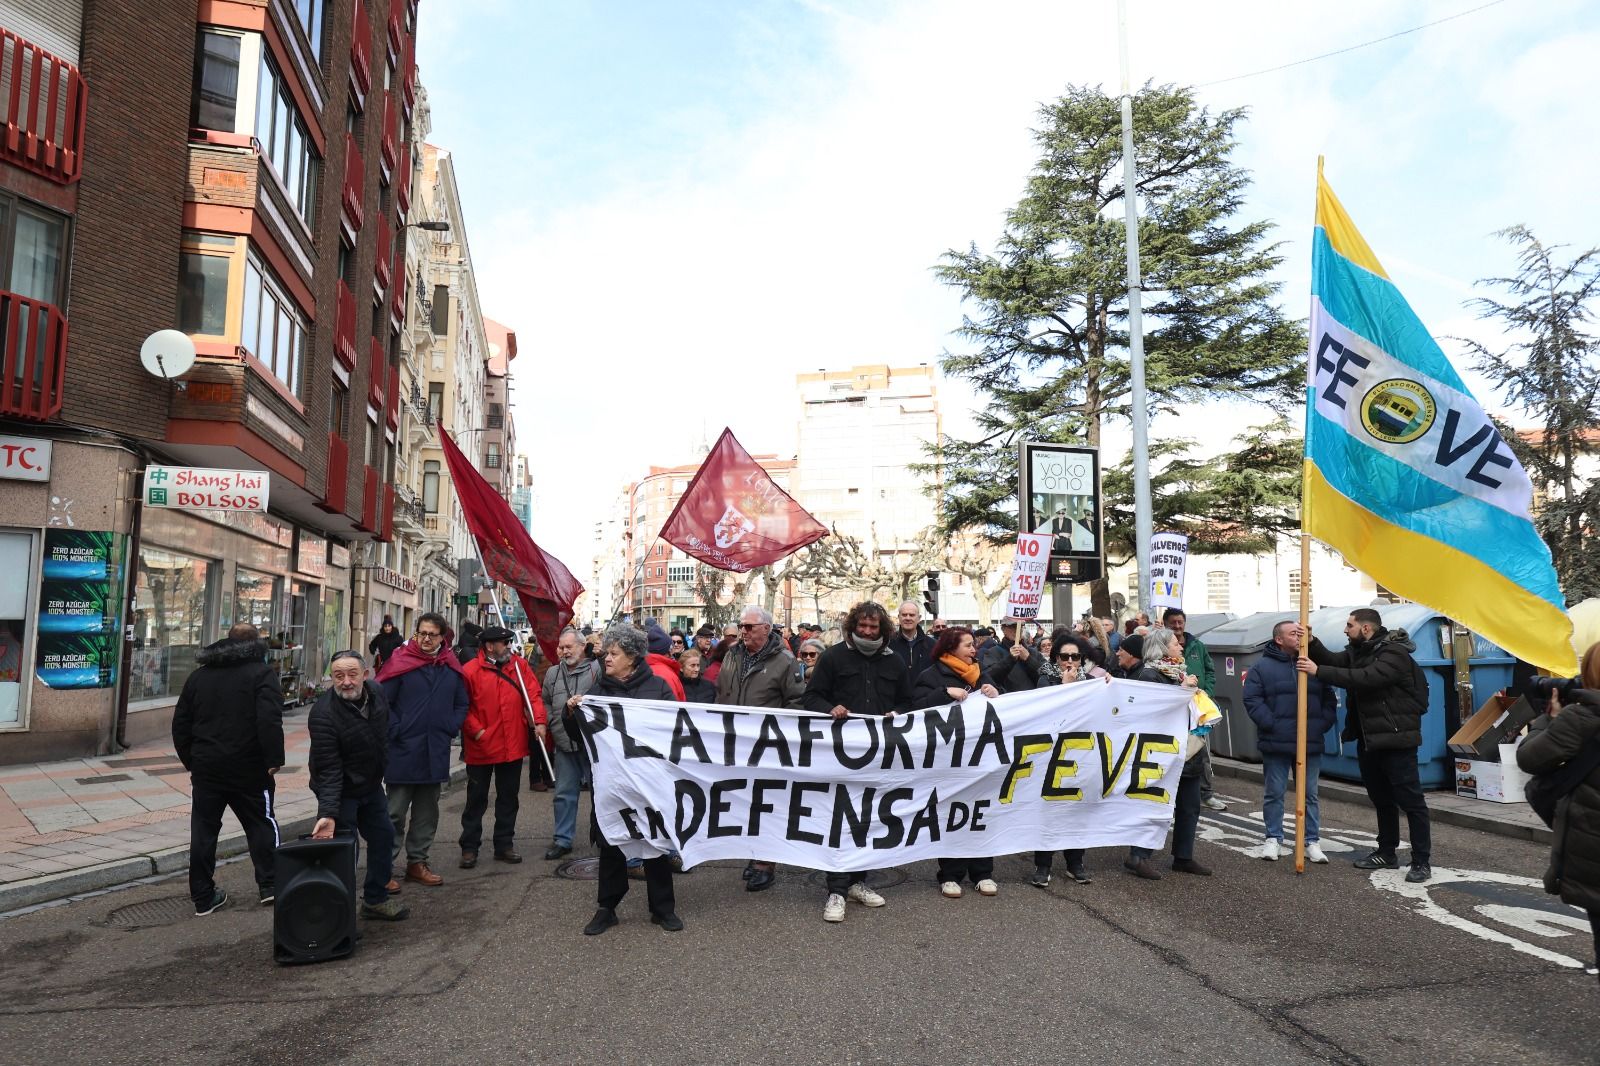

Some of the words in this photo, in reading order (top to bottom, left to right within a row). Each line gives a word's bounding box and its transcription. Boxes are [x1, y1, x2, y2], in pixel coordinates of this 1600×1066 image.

[1040, 454, 1086, 481] yoko
[148, 467, 169, 506] 中国
[1044, 476, 1083, 491] ono
[176, 492, 261, 509] BOLSOS
[69, 546, 94, 556] AZÚCAR
[1016, 538, 1040, 557] NO
[69, 555, 98, 563] MONSTER
[1169, 568, 1178, 579] DE
[1016, 574, 1042, 592] 15,4
[48, 600, 65, 608] ZERO
[65, 599, 90, 608] AZÚCAR
[65, 608, 95, 616] MONSTER
[1012, 606, 1038, 618] EUROS
[61, 653, 86, 662] AZÚCAR
[62, 661, 91, 669] MONSTER
[574, 701, 1011, 770] PLATAFORMA
[618, 806, 671, 841] EN
[674, 779, 941, 851] DEFENSA
[945, 800, 991, 833] DE
[998, 731, 1180, 804] FEVE
